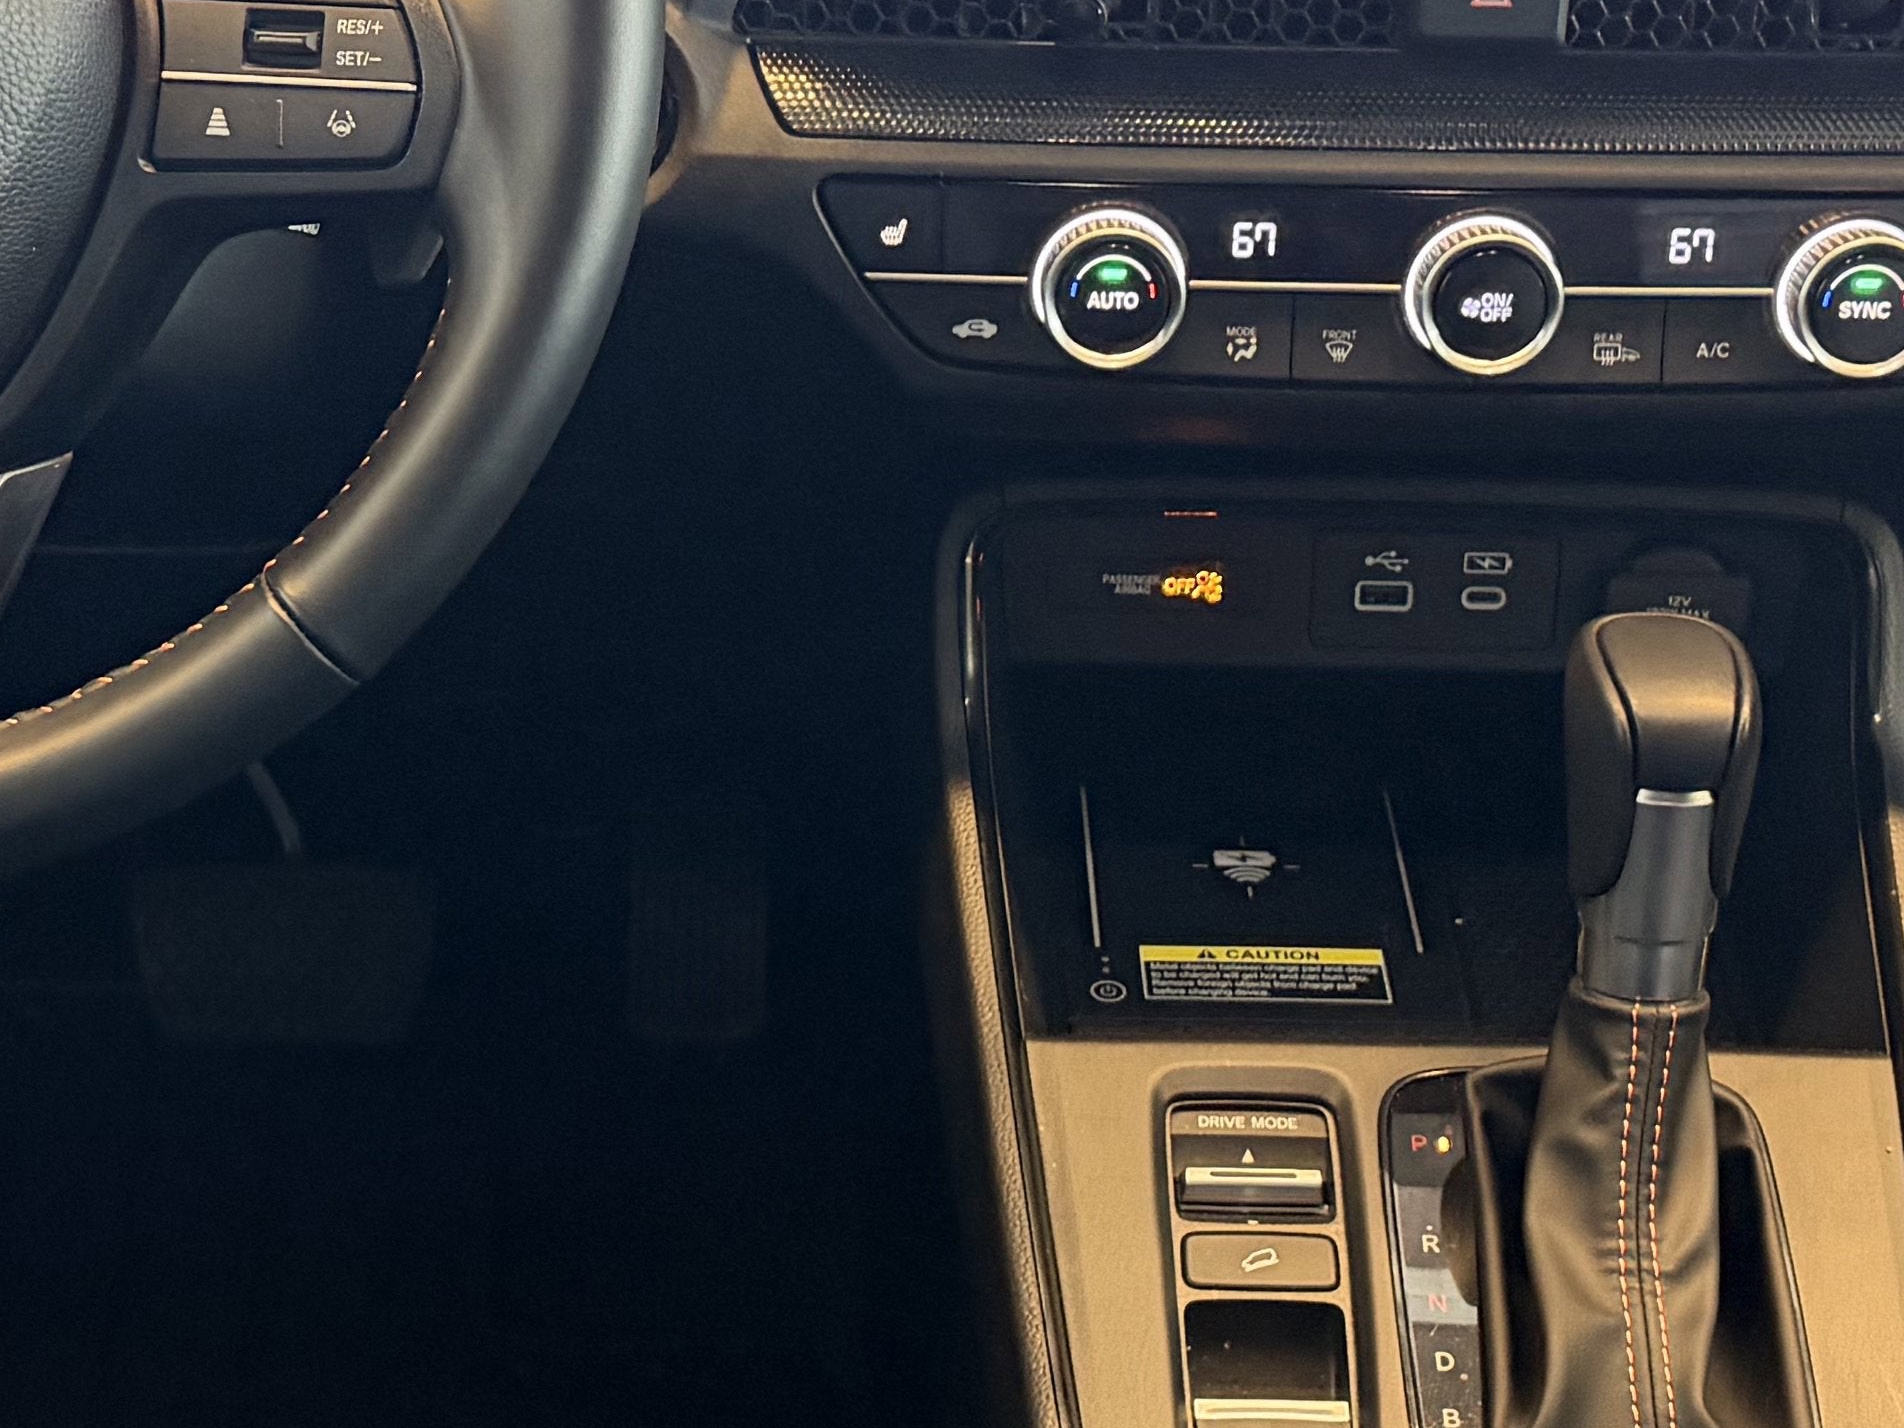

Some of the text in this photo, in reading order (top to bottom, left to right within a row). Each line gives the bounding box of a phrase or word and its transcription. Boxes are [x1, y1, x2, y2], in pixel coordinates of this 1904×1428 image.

[1232, 222, 1278, 258] 67
[1668, 227, 1715, 264] 67
[1086, 290, 1139, 310] AUTO
[1480, 292, 1514, 308] ON/
[1480, 307, 1513, 323] OFF
[1838, 300, 1891, 320] SYNC
[1226, 326, 1257, 336] MODE
[1322, 329, 1357, 341] FRONT
[1593, 332, 1623, 343] REAR
[1696, 342, 1730, 359] A/C
[1162, 576, 1195, 597] OFF
[1225, 949, 1320, 961] CAUTION
[1198, 1115, 1298, 1130] DRIVE MODE
[1411, 1135, 1427, 1152] P
[1421, 1234, 1441, 1253] R
[1428, 1295, 1447, 1312] N
[1435, 1351, 1455, 1372] D
[1442, 1408, 1461, 1428] B
